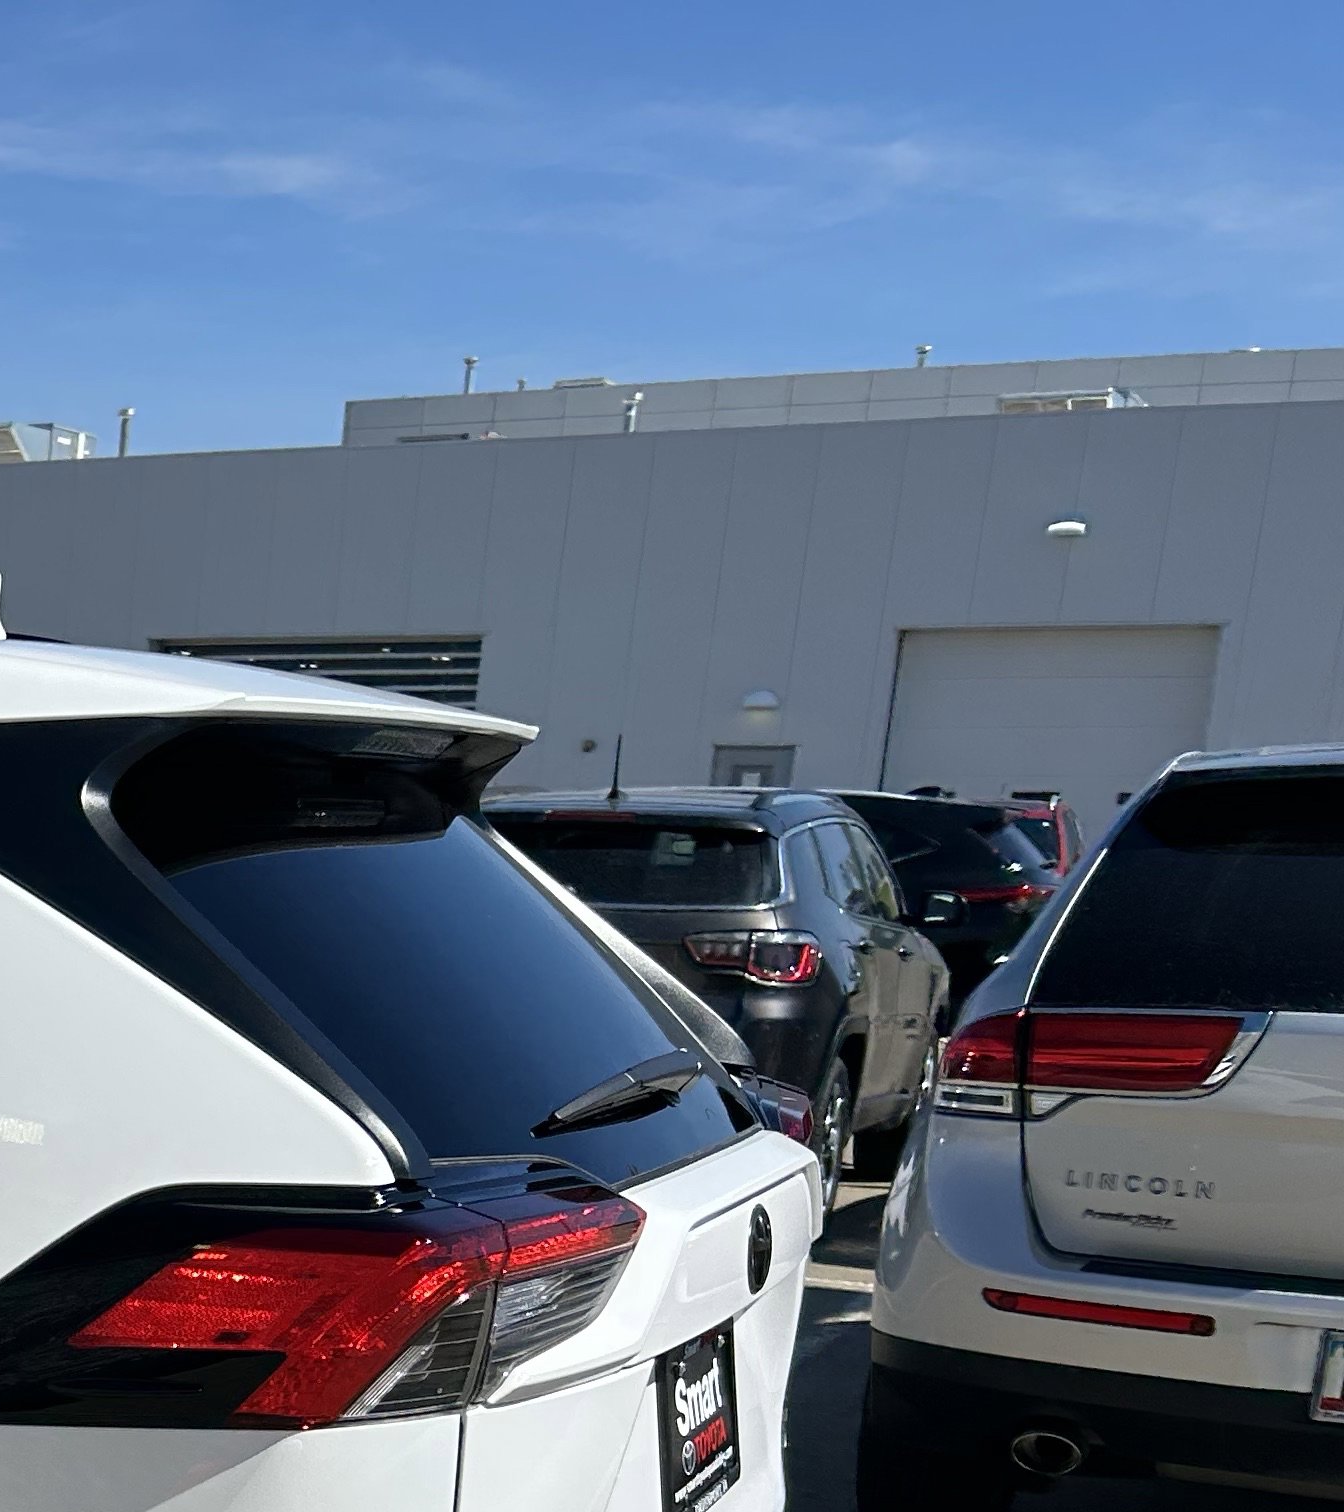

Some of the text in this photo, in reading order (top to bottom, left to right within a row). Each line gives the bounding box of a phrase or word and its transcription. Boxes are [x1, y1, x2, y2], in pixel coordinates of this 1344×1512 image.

[1065, 1169, 1216, 1200] LINCOLN
[674, 1357, 723, 1437] Smart
[693, 1416, 728, 1465] TOYOTA
